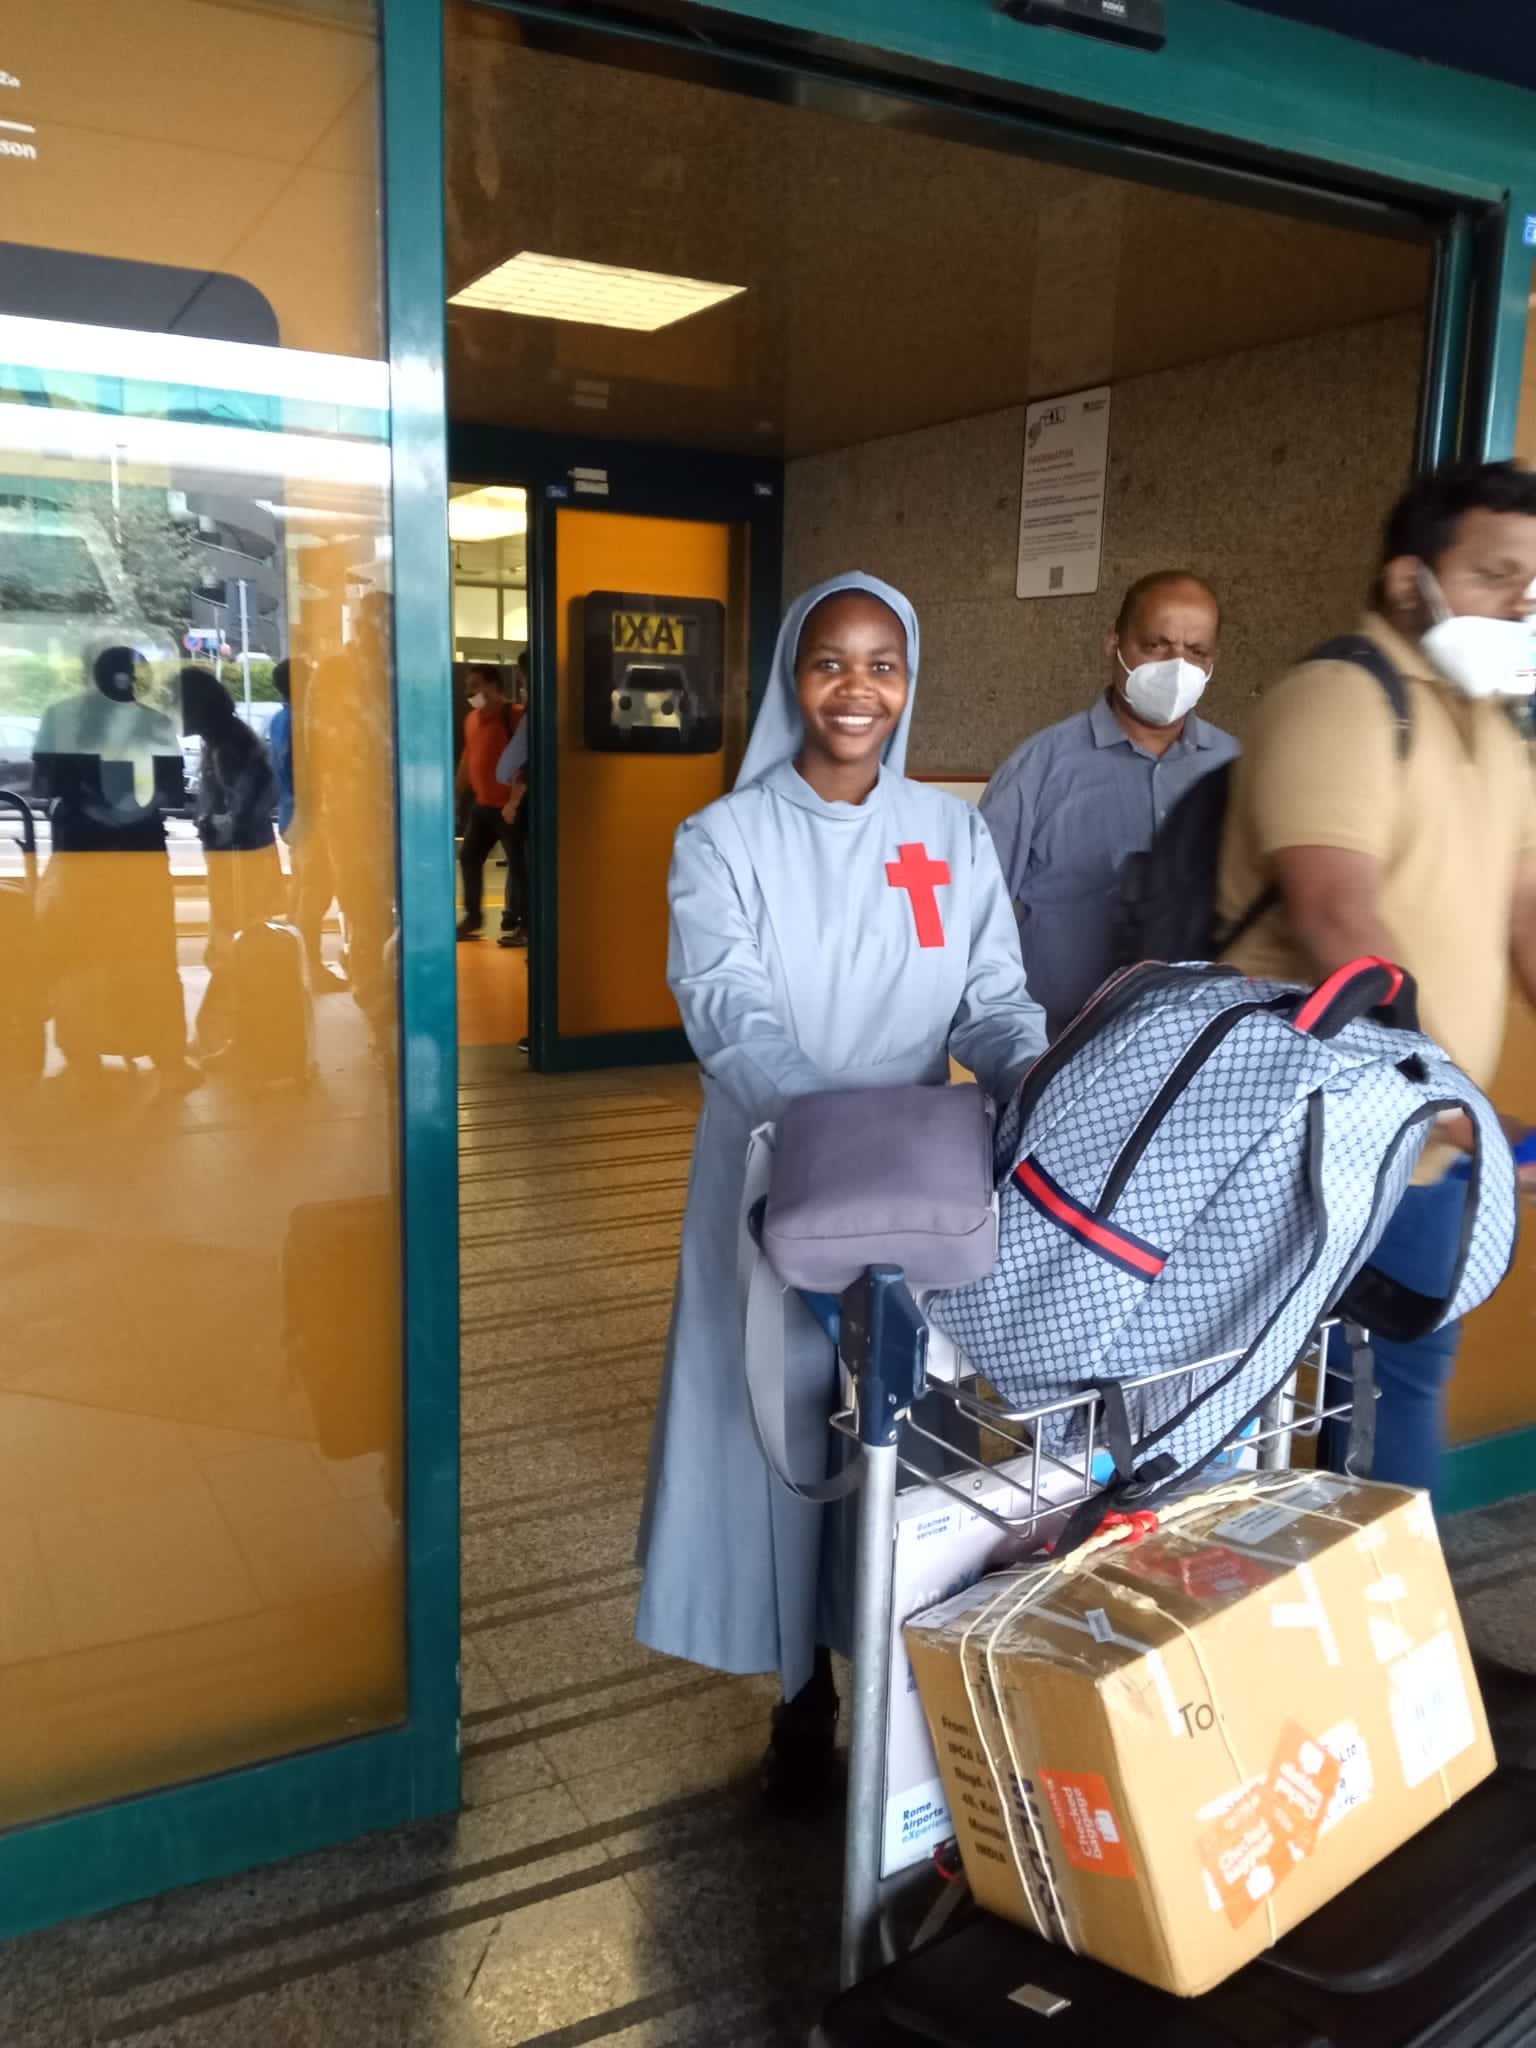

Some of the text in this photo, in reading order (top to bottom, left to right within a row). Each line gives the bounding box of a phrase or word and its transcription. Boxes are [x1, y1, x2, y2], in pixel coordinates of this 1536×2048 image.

[917, 1515, 950, 1531] Business
[917, 1525, 948, 1540] services
[902, 1801, 932, 1821] Rome
[902, 1807, 945, 1832] Airports
[1062, 1786, 1092, 1857] Checked
[1073, 1787, 1104, 1860] baggage
